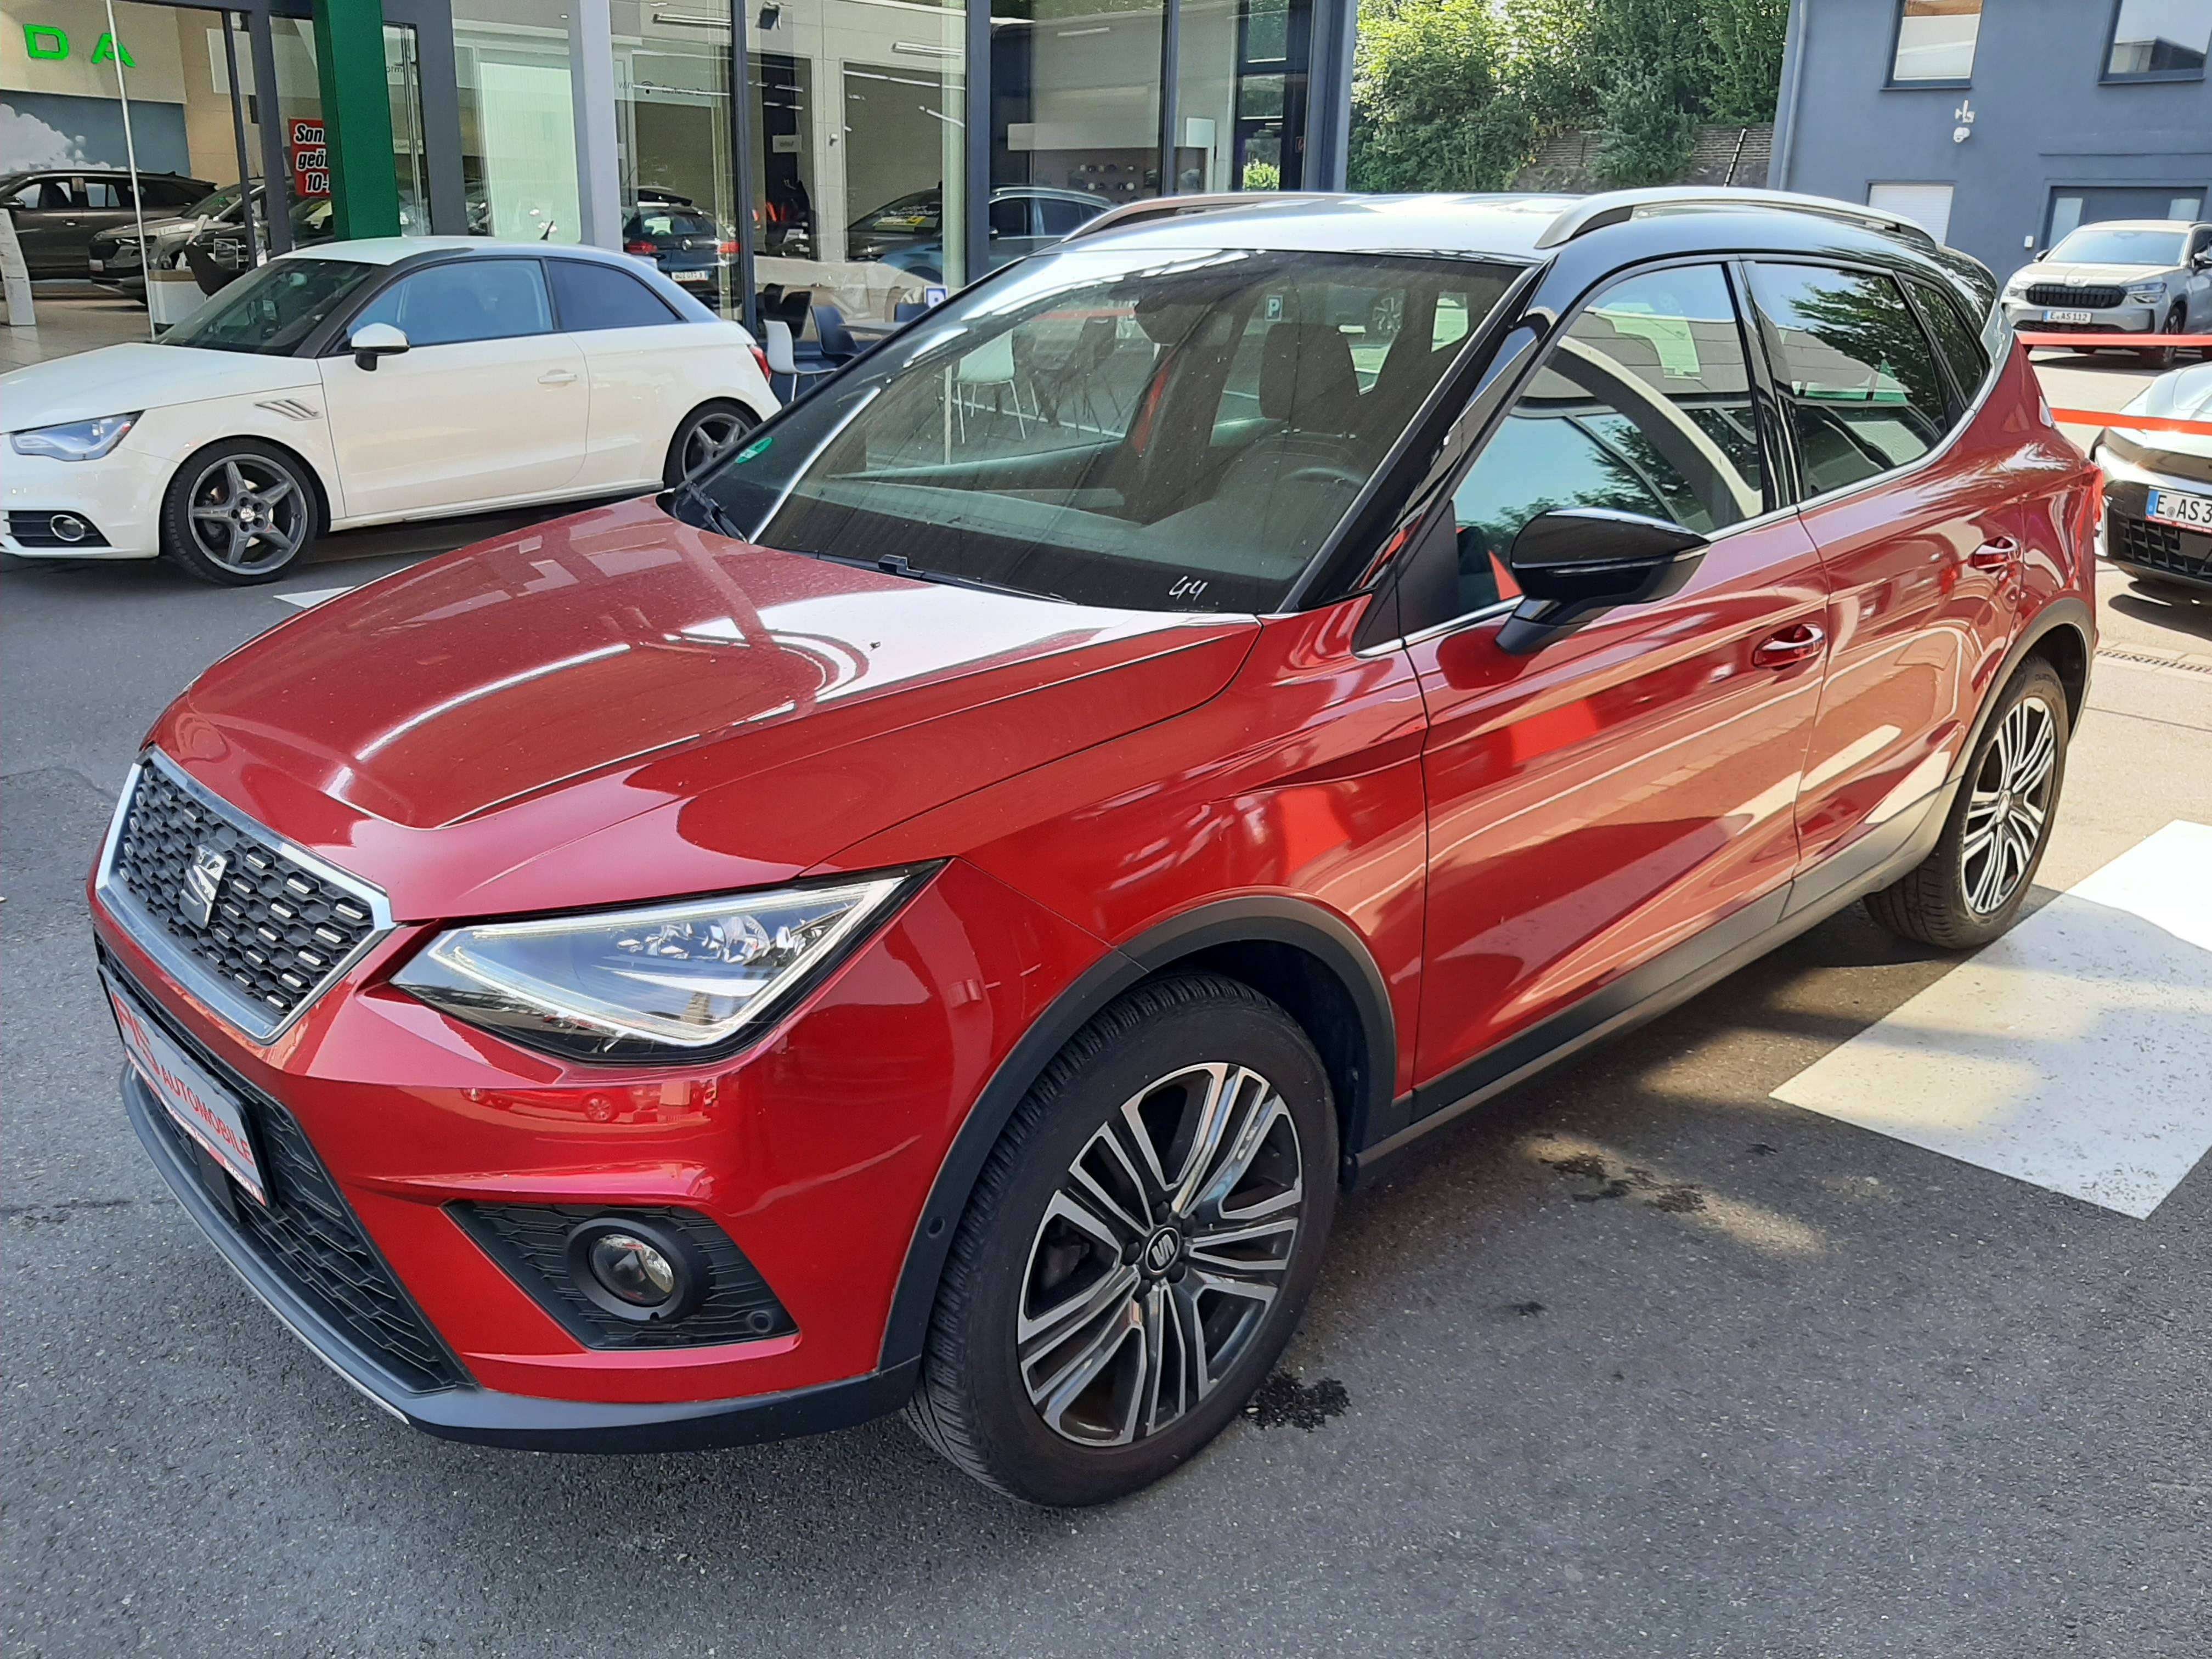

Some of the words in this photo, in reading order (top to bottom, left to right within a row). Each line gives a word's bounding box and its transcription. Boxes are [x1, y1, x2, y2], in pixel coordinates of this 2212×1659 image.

[295, 124, 325, 143] Son
[2156, 494, 2167, 515] E
[1169, 575, 1209, 601] 44
[161, 1064, 254, 1167] AUTOMOBILE
